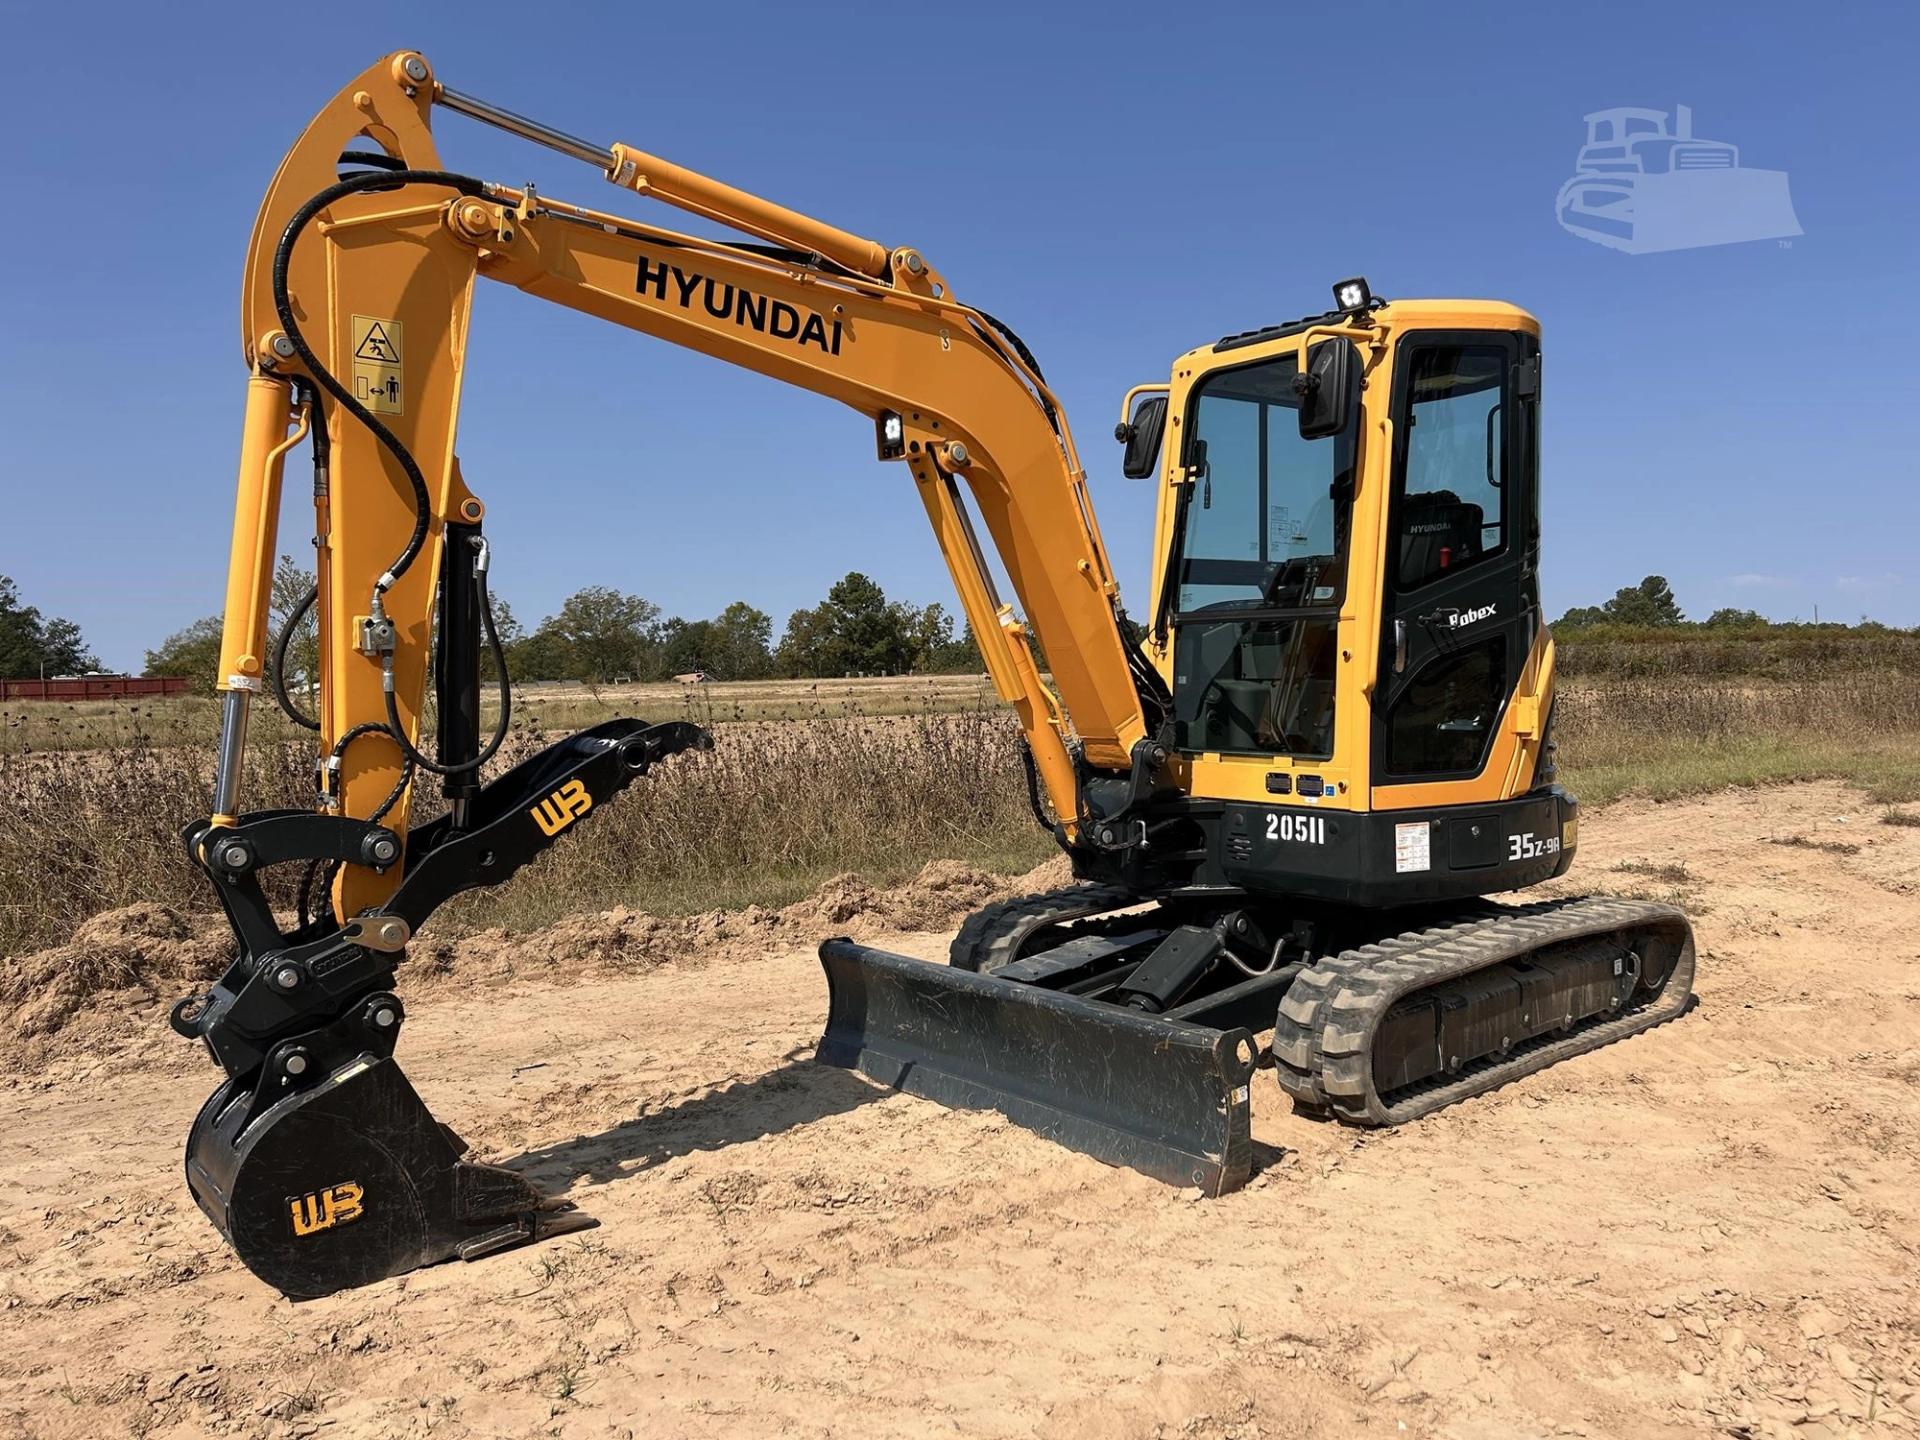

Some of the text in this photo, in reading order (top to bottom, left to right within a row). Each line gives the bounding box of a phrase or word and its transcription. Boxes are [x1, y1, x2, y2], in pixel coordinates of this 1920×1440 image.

[635, 255, 843, 357] HYUNDAI
[1410, 522, 1452, 534] HYUNDAI
[1266, 813, 1325, 844] 20511
